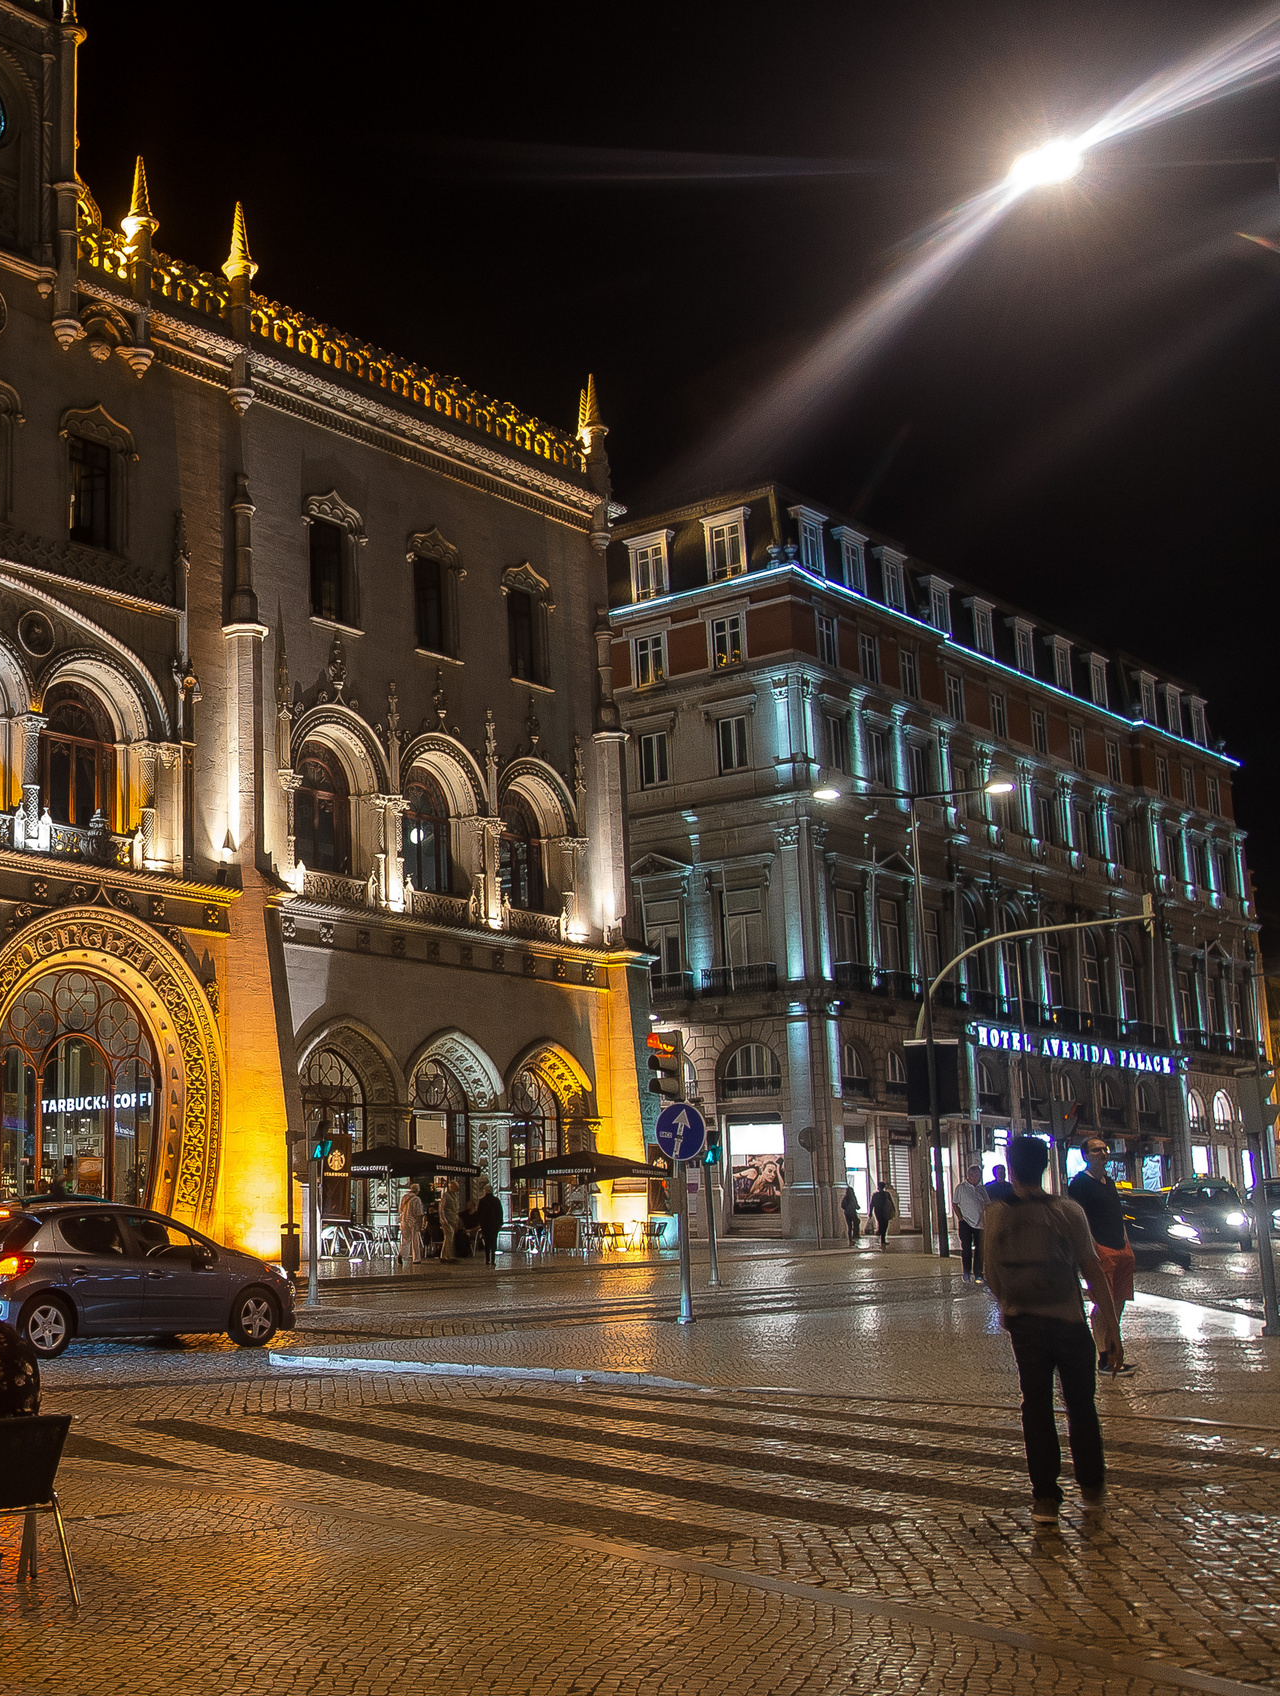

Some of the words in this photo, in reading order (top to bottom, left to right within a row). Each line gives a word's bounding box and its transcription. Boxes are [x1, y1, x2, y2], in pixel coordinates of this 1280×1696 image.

[978, 1026, 1031, 1052] HOTEL
[1042, 1038, 1111, 1065] AVENIDA
[1120, 1050, 1171, 1074] PALACE
[41, 1095, 109, 1113] TARBUCKS
[113, 1092, 152, 1109] COFF
